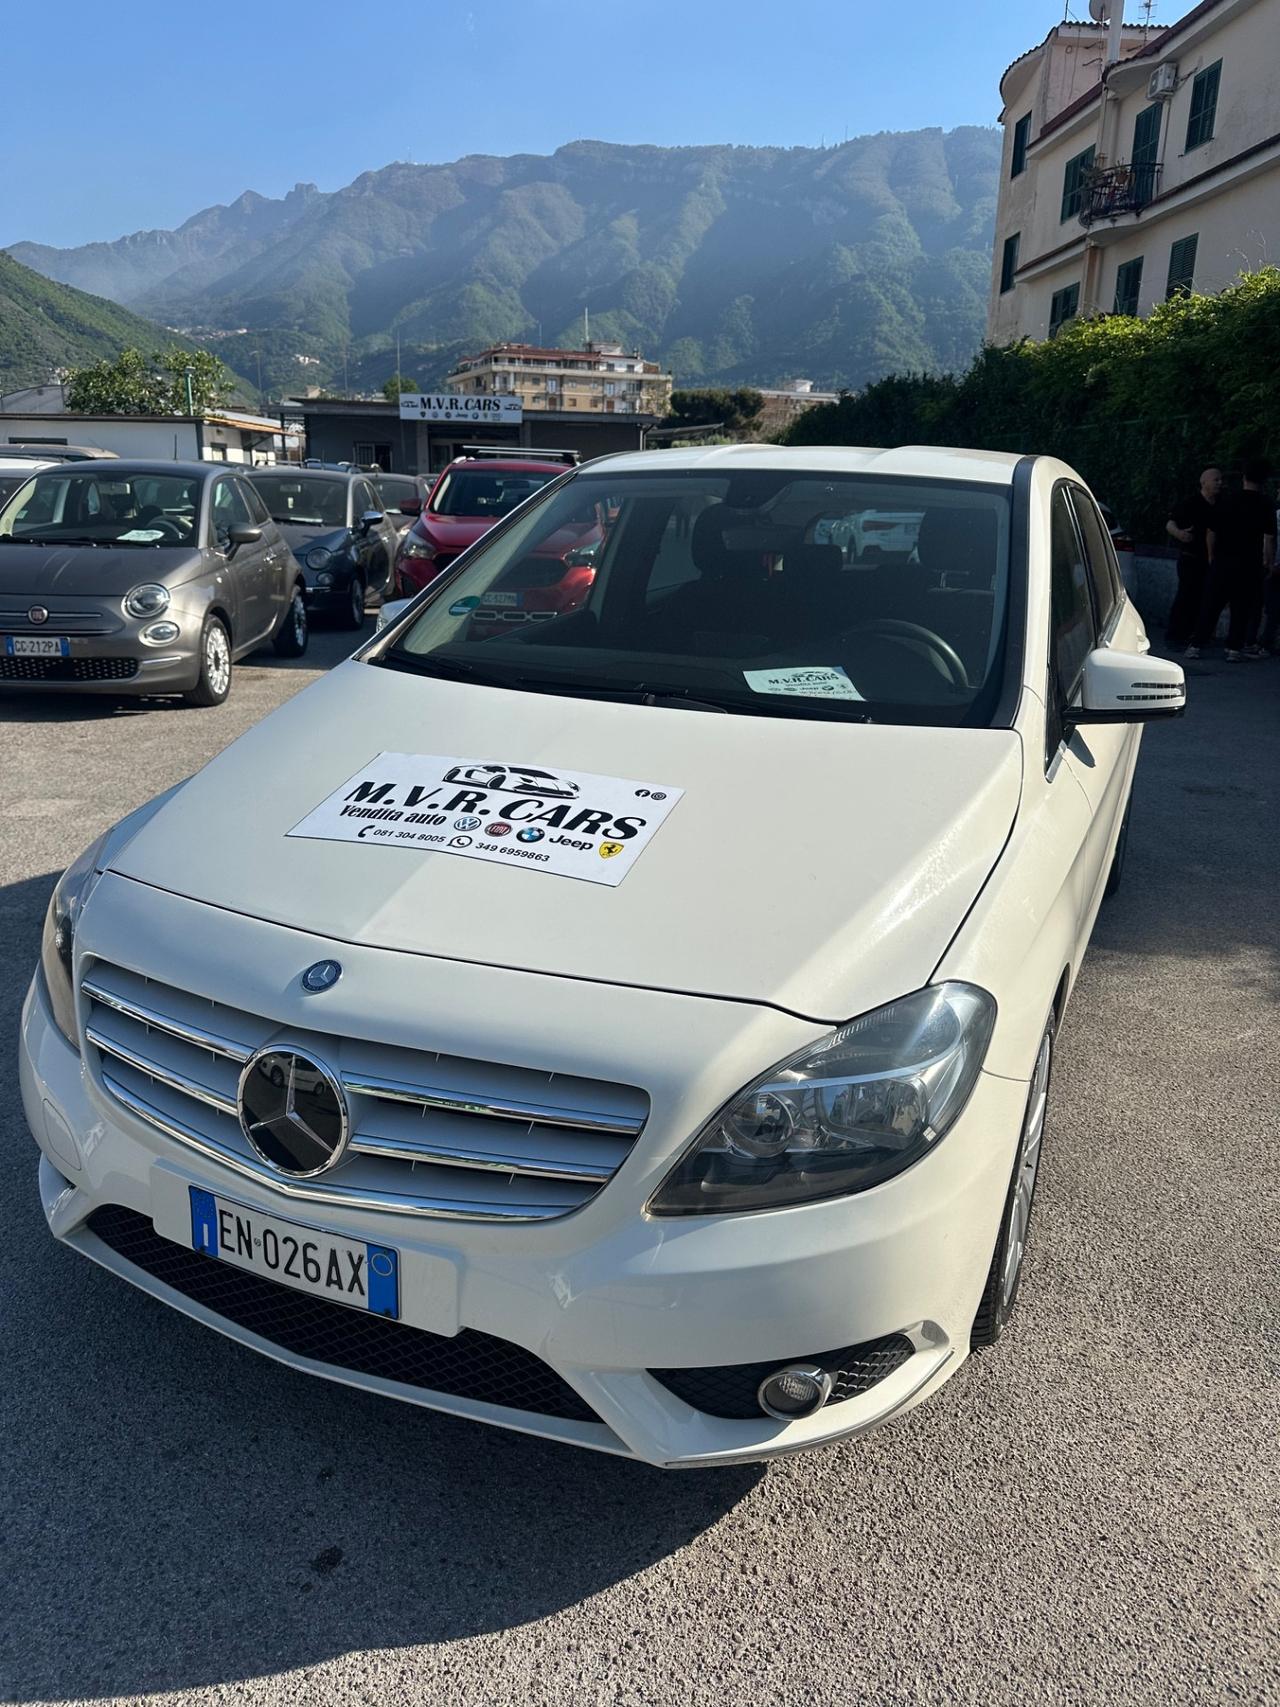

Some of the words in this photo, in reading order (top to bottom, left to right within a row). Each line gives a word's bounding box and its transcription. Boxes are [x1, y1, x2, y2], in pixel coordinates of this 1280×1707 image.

[339, 804, 404, 821] Vendita
[404, 812, 447, 826] auto
[373, 828, 394, 836] 081
[395, 831, 417, 840] 304
[417, 834, 447, 843] 8005
[549, 835, 594, 851] Jeep
[475, 842, 498, 853] 349
[499, 846, 550, 862] 6959863
